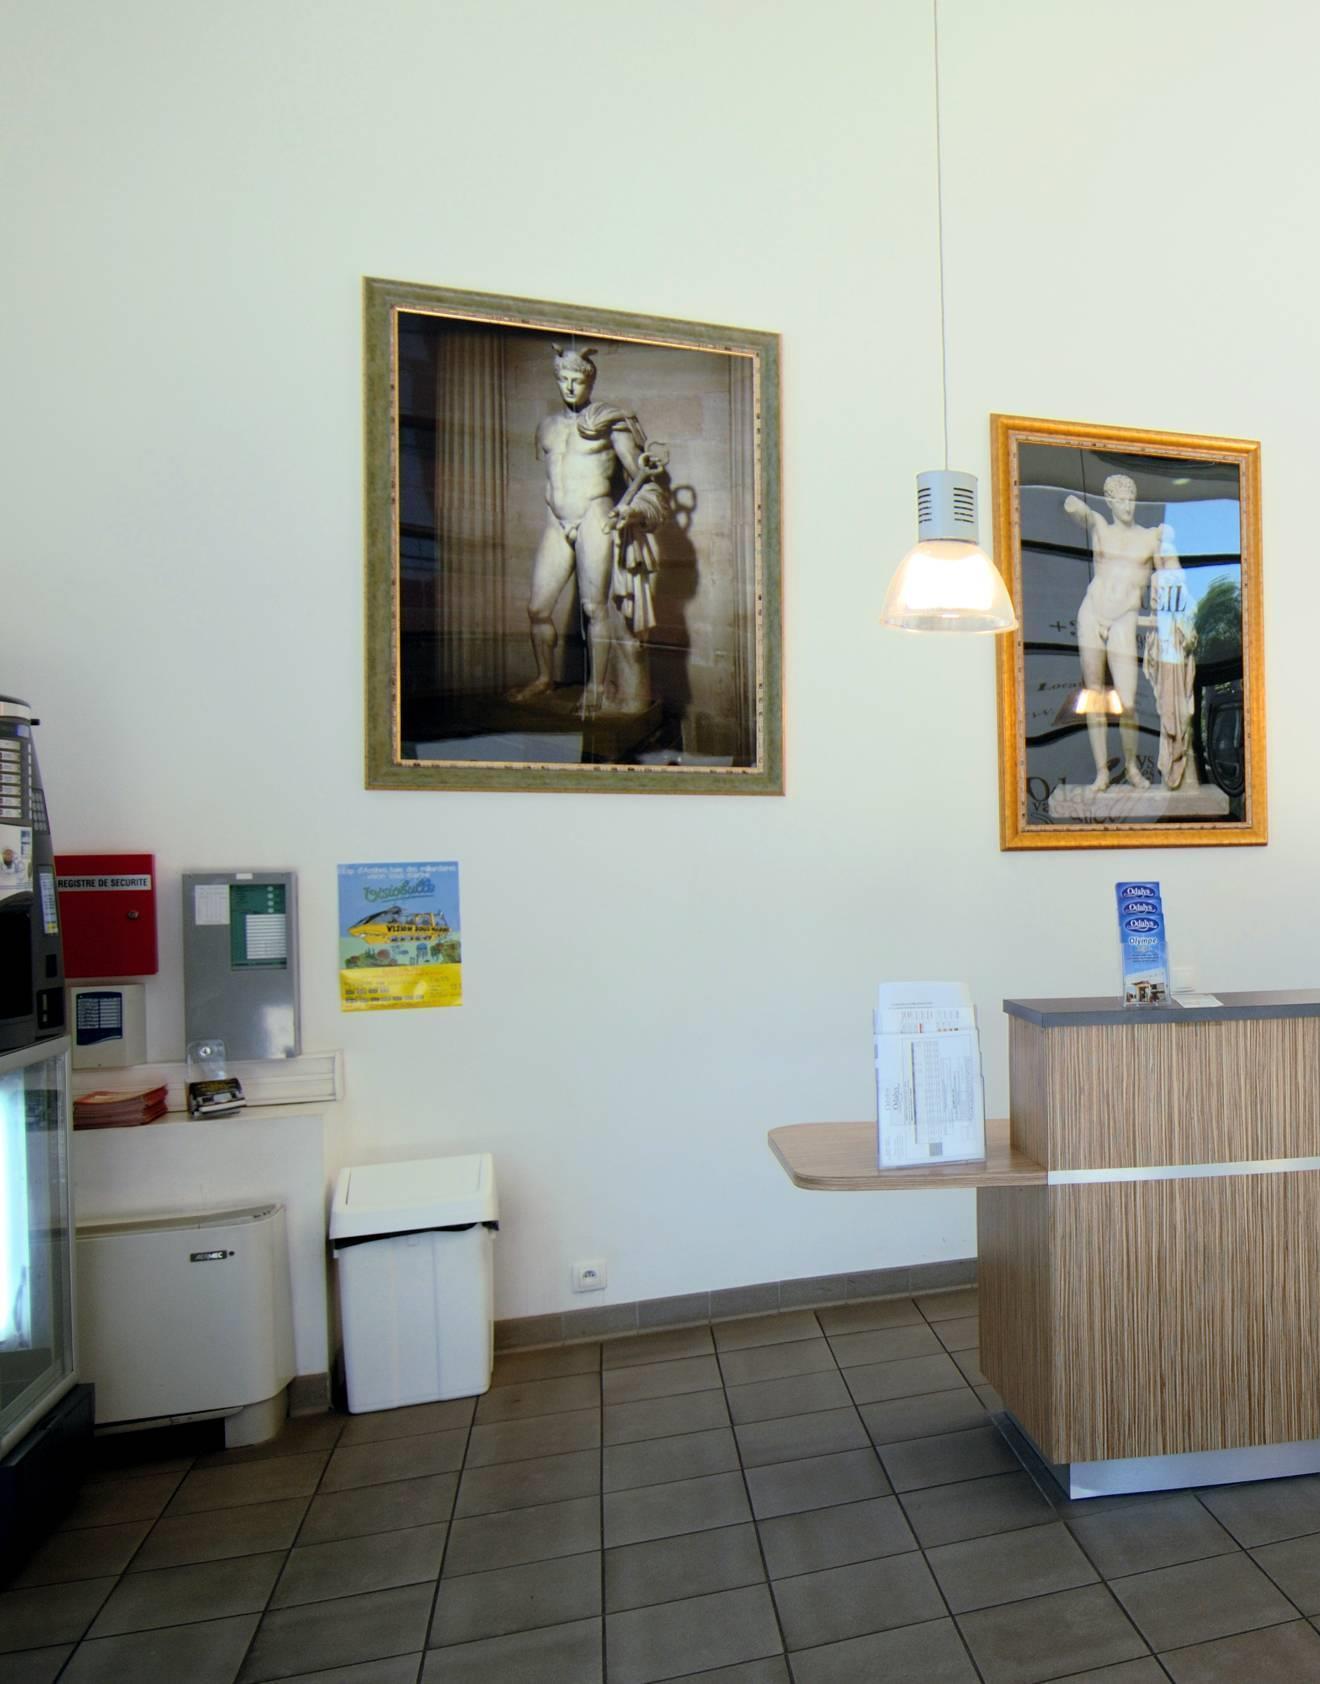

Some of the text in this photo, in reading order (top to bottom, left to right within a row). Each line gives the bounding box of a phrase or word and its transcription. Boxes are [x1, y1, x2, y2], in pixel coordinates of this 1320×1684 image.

[58, 879, 95, 888] REGISTRE
[98, 878, 109, 887] DE
[1127, 887, 1151, 896] Odalys
[1129, 903, 1153, 912] Odalys
[1130, 919, 1155, 928] Odalys
[1128, 936, 1159, 945] Olympe
